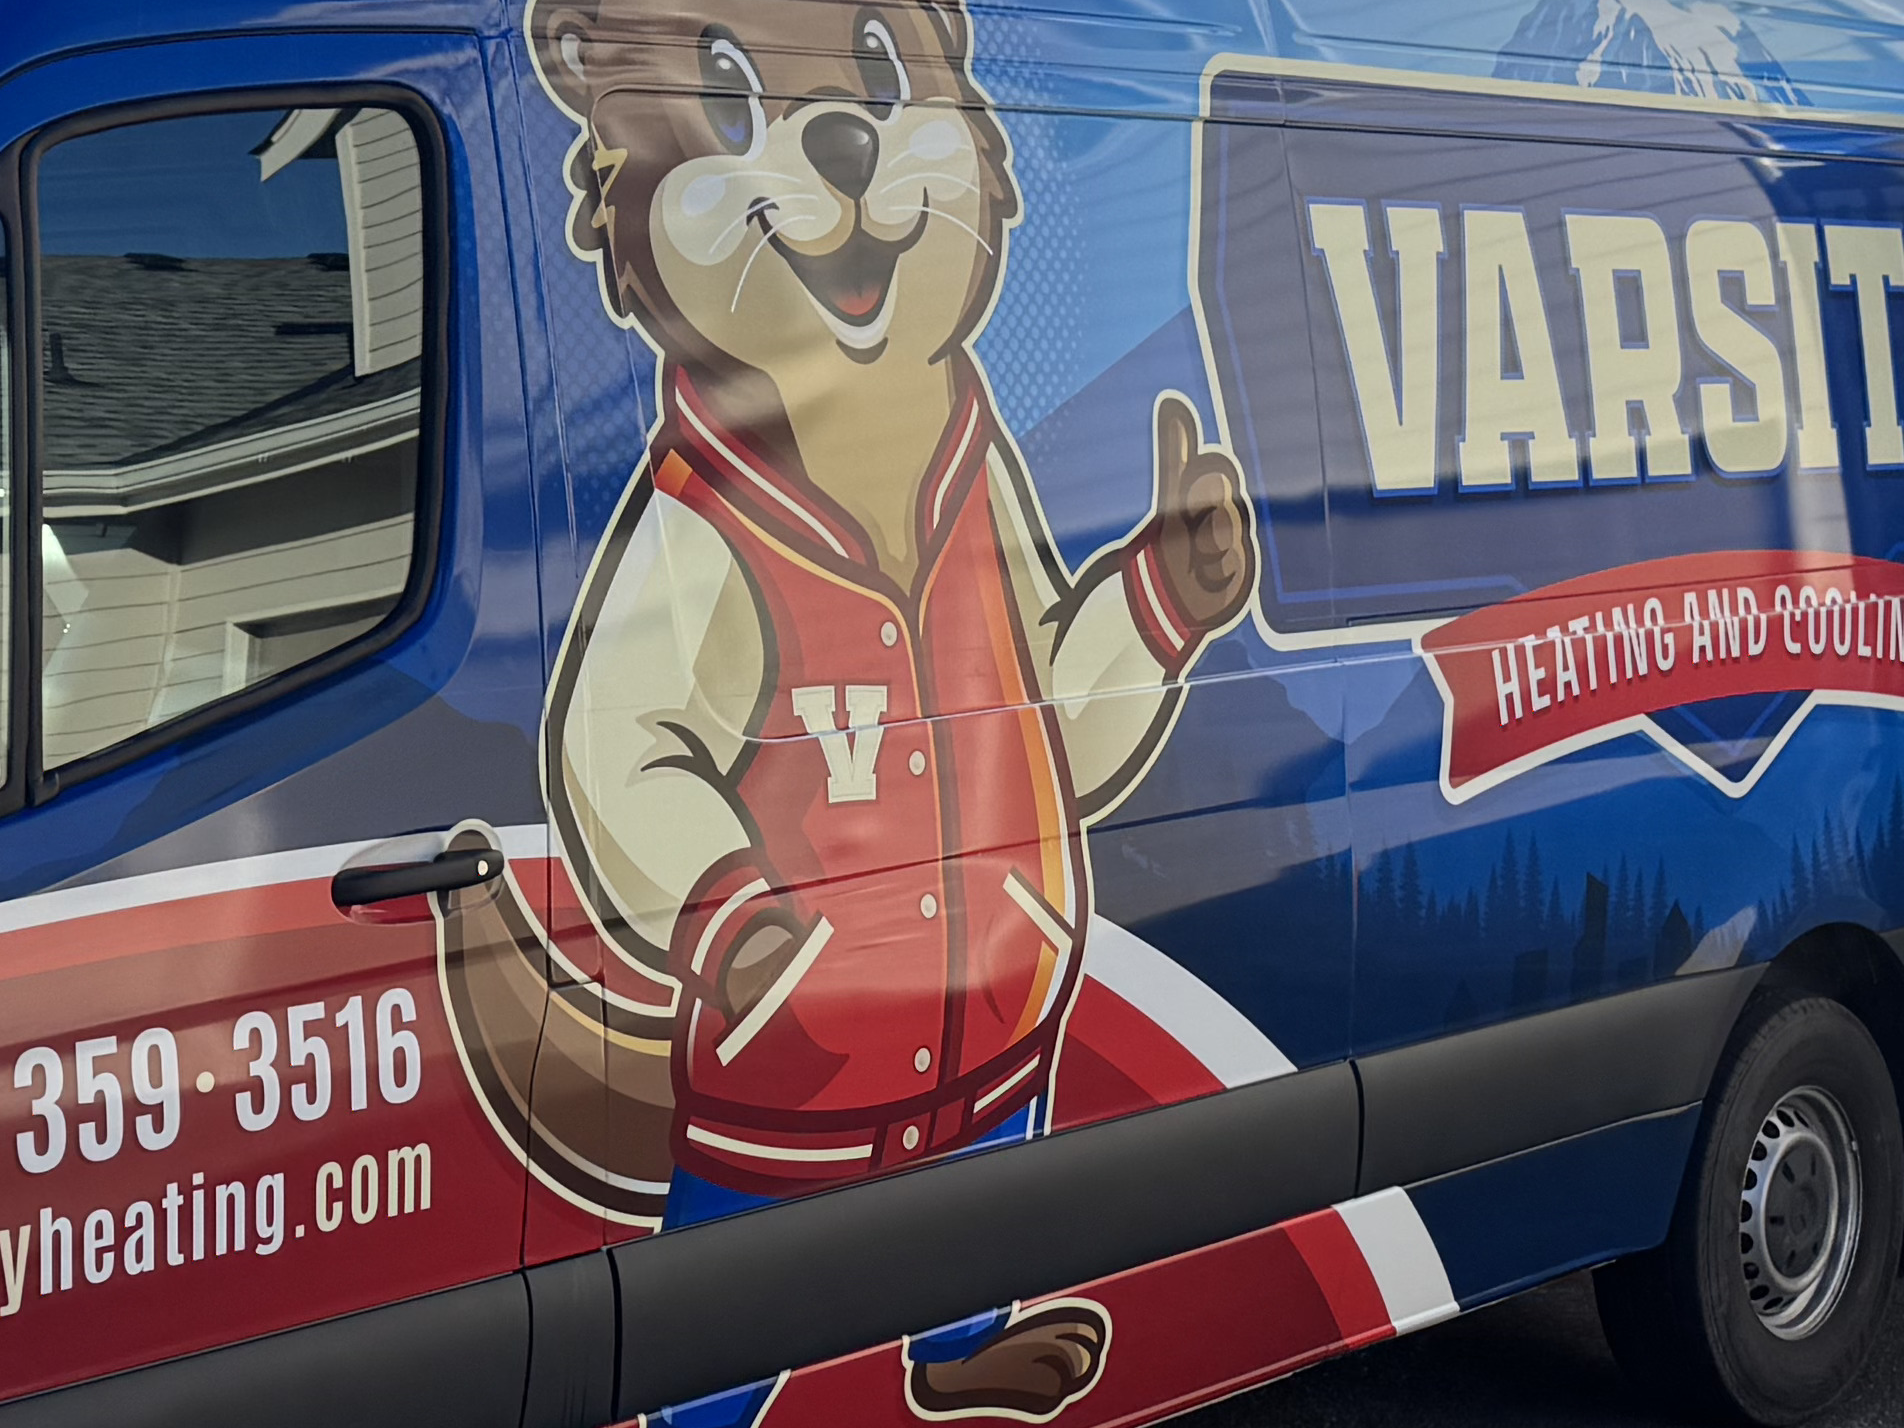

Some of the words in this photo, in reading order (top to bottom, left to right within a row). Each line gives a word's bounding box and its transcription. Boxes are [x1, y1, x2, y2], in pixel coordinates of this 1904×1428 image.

[1491, 598, 1678, 727] HEATING
[1683, 587, 1768, 665] AND
[791, 685, 888, 804] V
